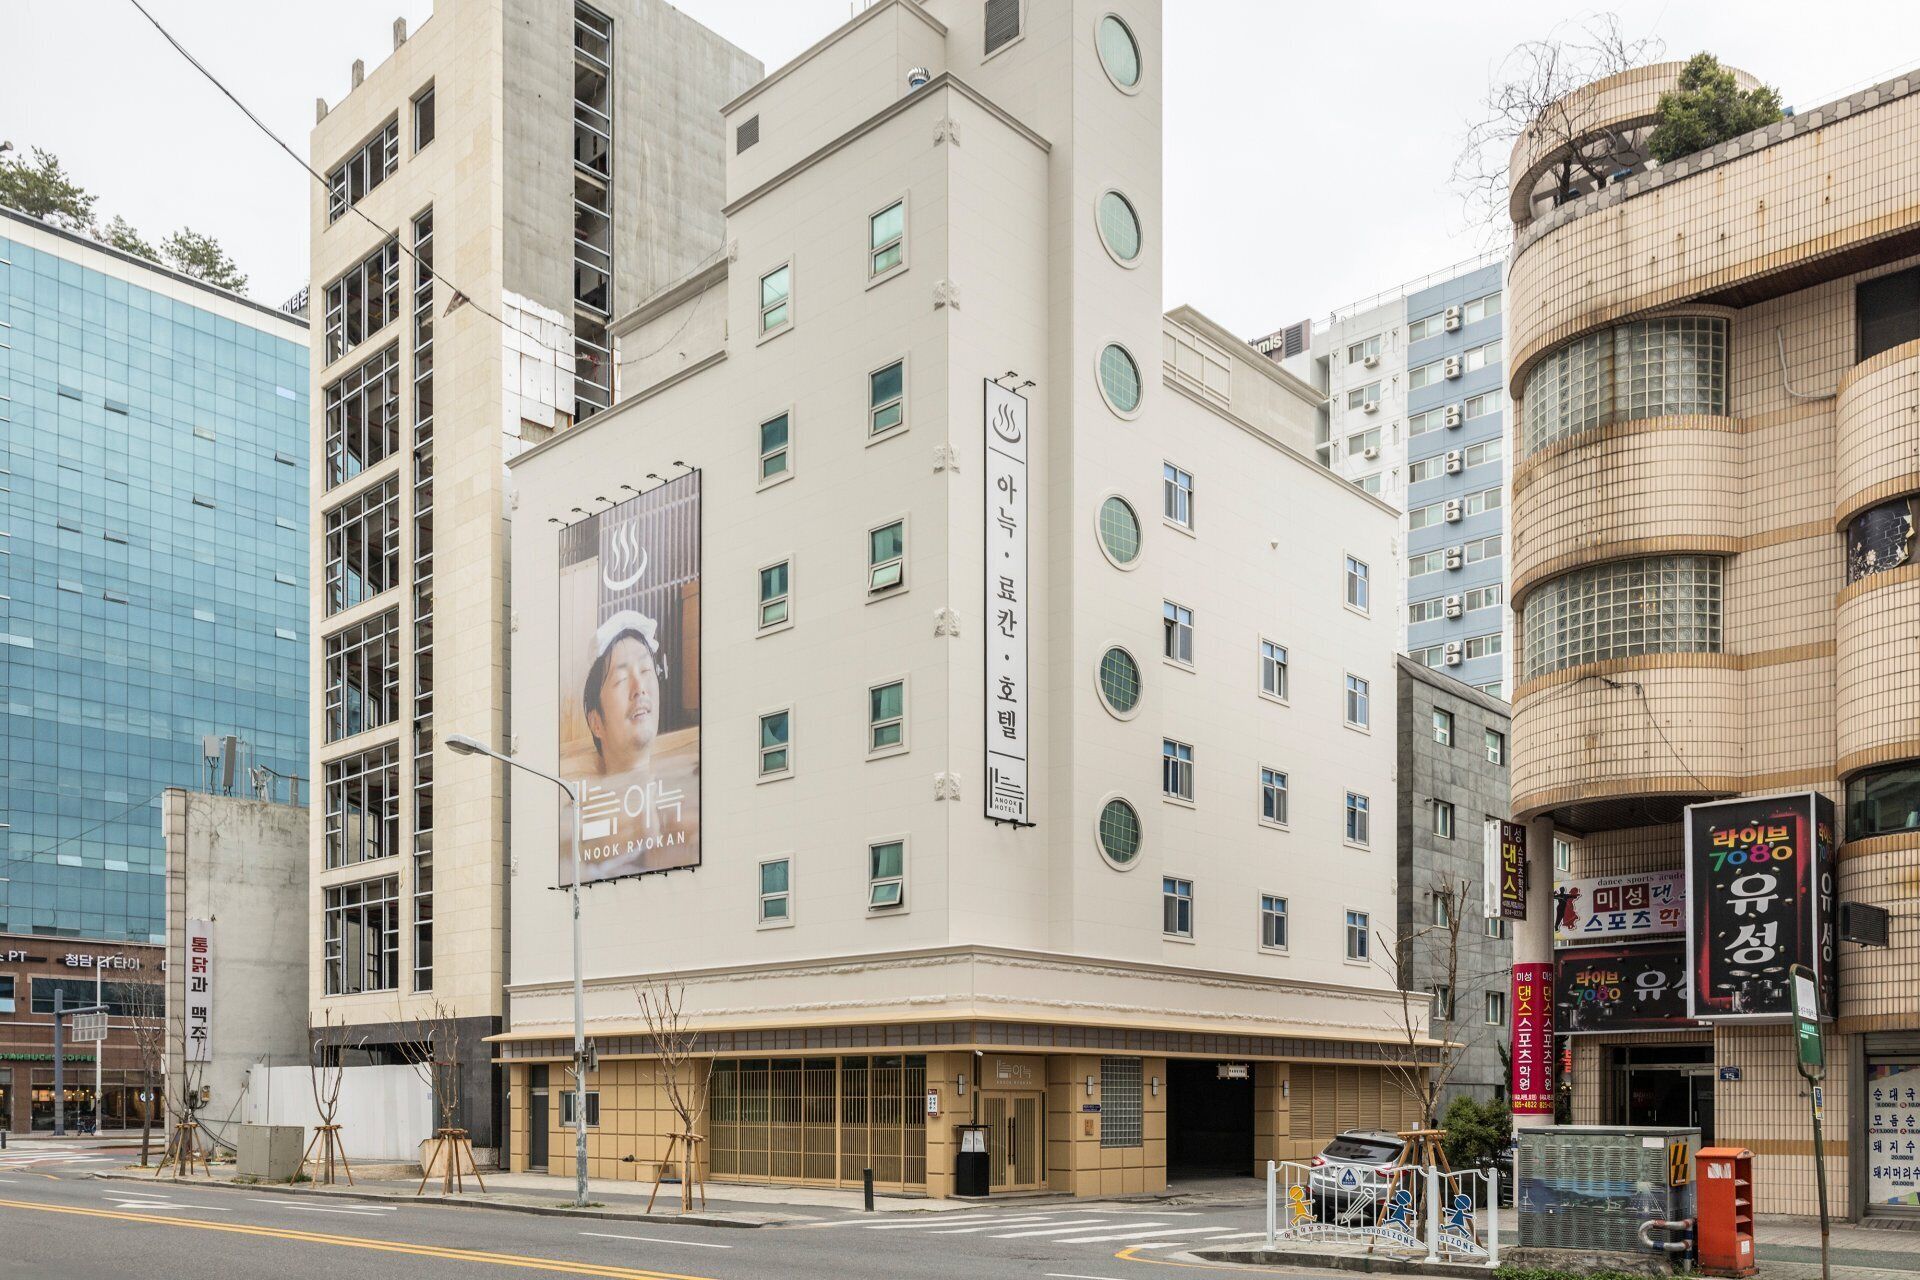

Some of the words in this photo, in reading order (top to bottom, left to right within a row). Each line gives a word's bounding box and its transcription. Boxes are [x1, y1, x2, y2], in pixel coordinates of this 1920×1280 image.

[997, 675, 1017, 740] 호텔
[995, 797, 1017, 806] ANOOK
[995, 804, 1016, 813] HOTEL
[627, 831, 686, 855] RYOKAN
[1712, 825, 1790, 848] 라이브
[1709, 844, 1793, 872] 7080
[1502, 843, 1517, 900] 댄스
[1597, 877, 1623, 886] dance
[1626, 874, 1654, 884] sports
[1596, 886, 1643, 909] 미성
[1724, 872, 1779, 965] 유성
[8, 950, 28, 962] PT
[65, 953, 93, 968] 청담
[191, 936, 208, 993] 통닭과
[1516, 972, 1532, 982] 미성
[1576, 970, 1620, 987] 라이브
[1573, 985, 1621, 1006] 7080
[190, 1006, 208, 1042] 맥주
